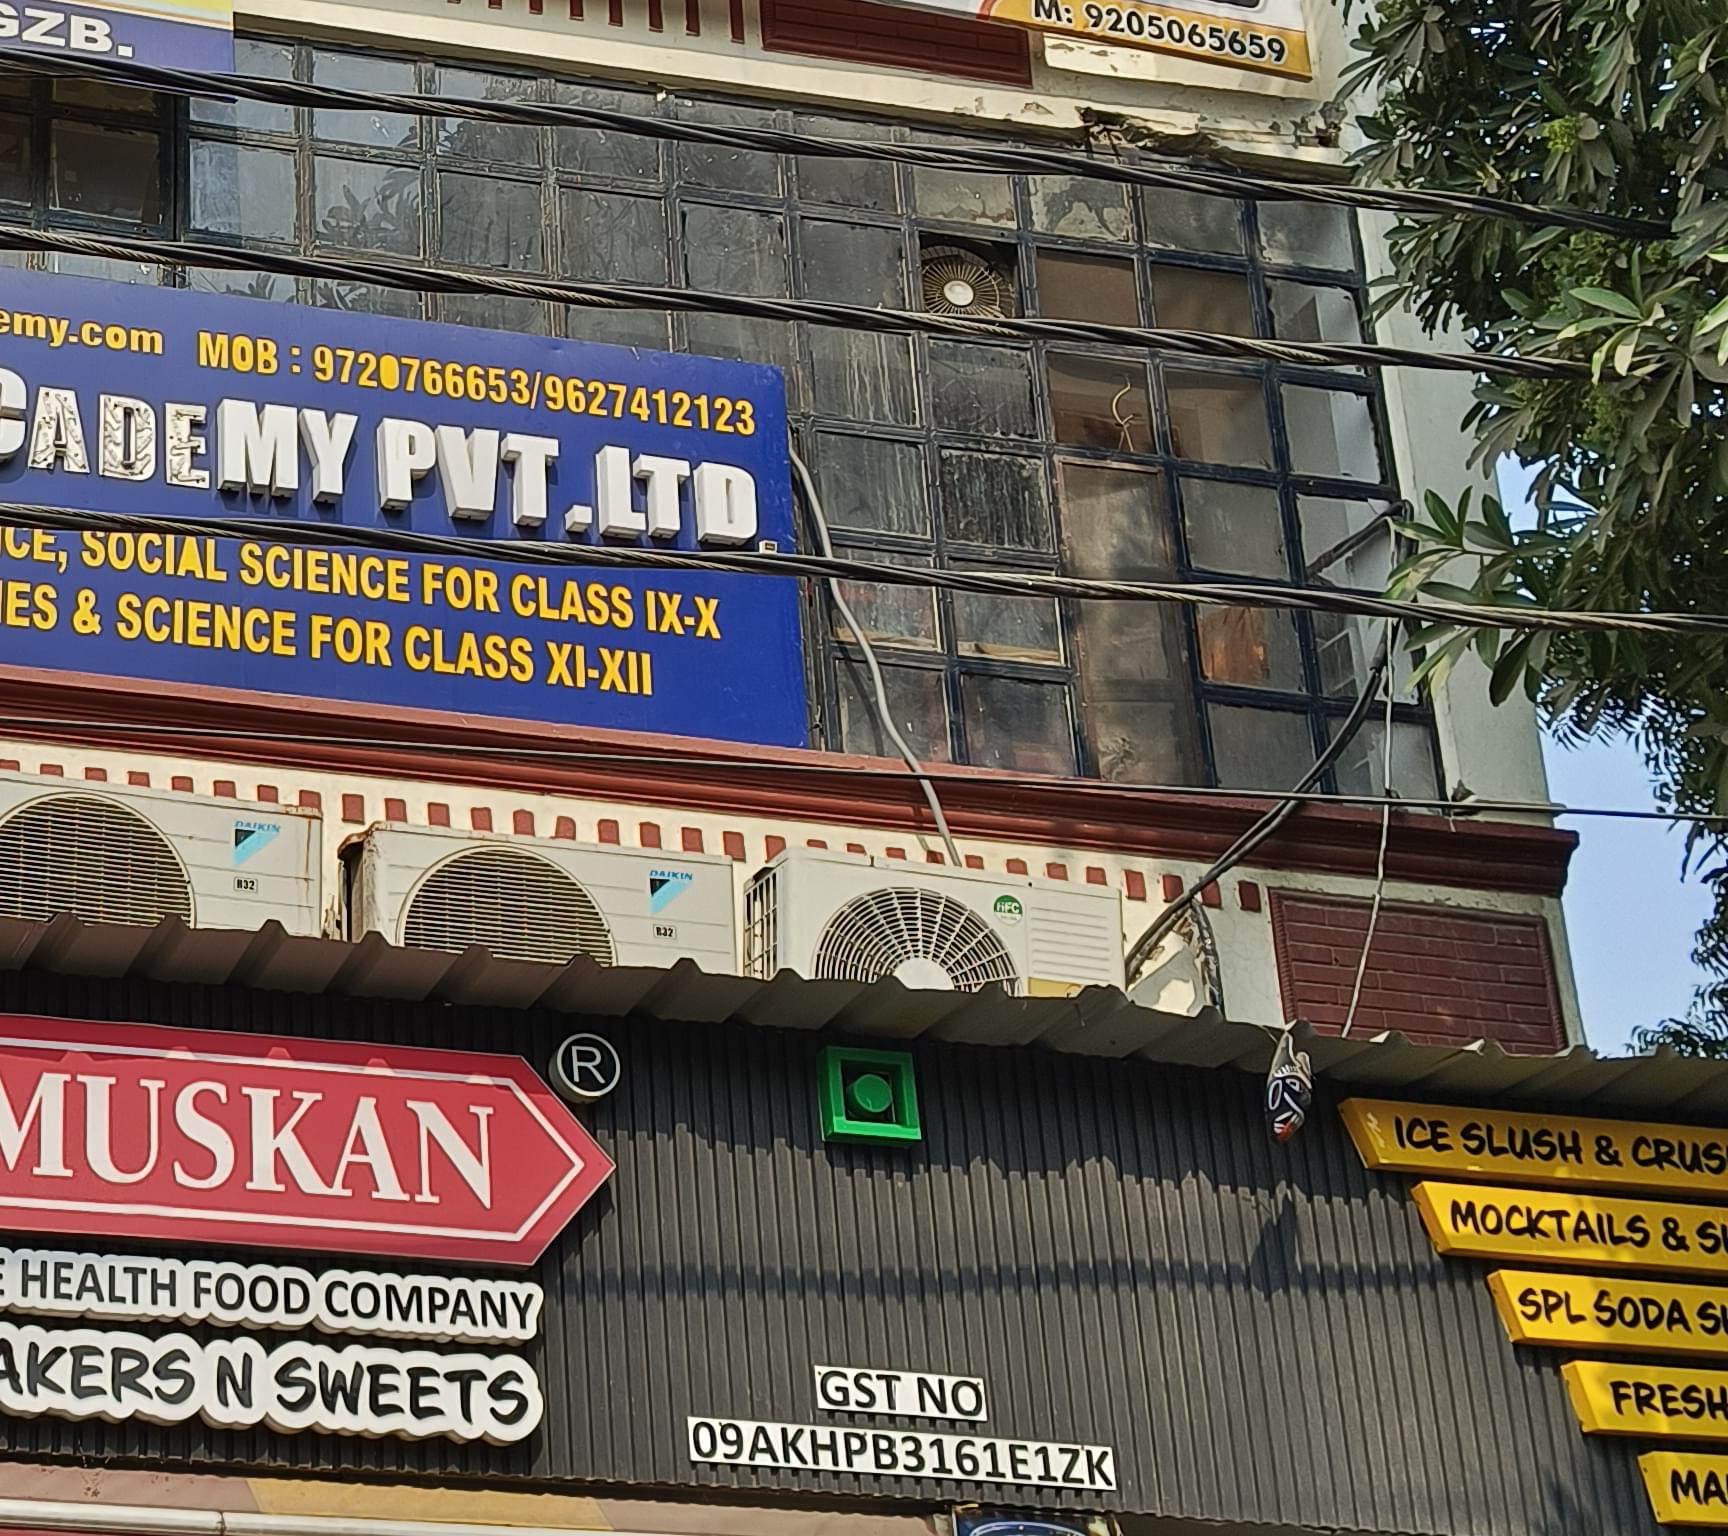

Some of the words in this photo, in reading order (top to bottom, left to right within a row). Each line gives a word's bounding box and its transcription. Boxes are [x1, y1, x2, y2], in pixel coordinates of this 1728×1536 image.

[1085, 2, 1286, 64] 9205065659
[82, 530, 228, 581] SOCIAL
[240, 542, 410, 603] SCIENCE
[423, 564, 500, 613] FOR
[511, 576, 634, 629] CLASS
[646, 591, 722, 640] IX-X
[116, 592, 297, 656] SCIENCE
[311, 615, 391, 666] FOR
[404, 625, 534, 683] CLASS
[547, 643, 654, 697] XI-XII
[649, 869, 693, 881] DAIKIN
[1394, 1116, 1453, 1150] ICE
[1460, 1122, 1582, 1164] SLUSH
[1631, 1136, 1728, 1175] CRUS
[1450, 1199, 1650, 1248] MOCKTAILS
[20, 1259, 178, 1309] HEALTH
[193, 1270, 311, 1316] FOOD
[324, 1279, 536, 1331] COMPANY
[1518, 1288, 1586, 1324] SPL
[1594, 1290, 1692, 1334] SODA
[275, 1358, 529, 1425] SWEETS
[819, 1370, 901, 1411] GST
[917, 1377, 983, 1417] NO
[1610, 1380, 1728, 1420] FRESH
